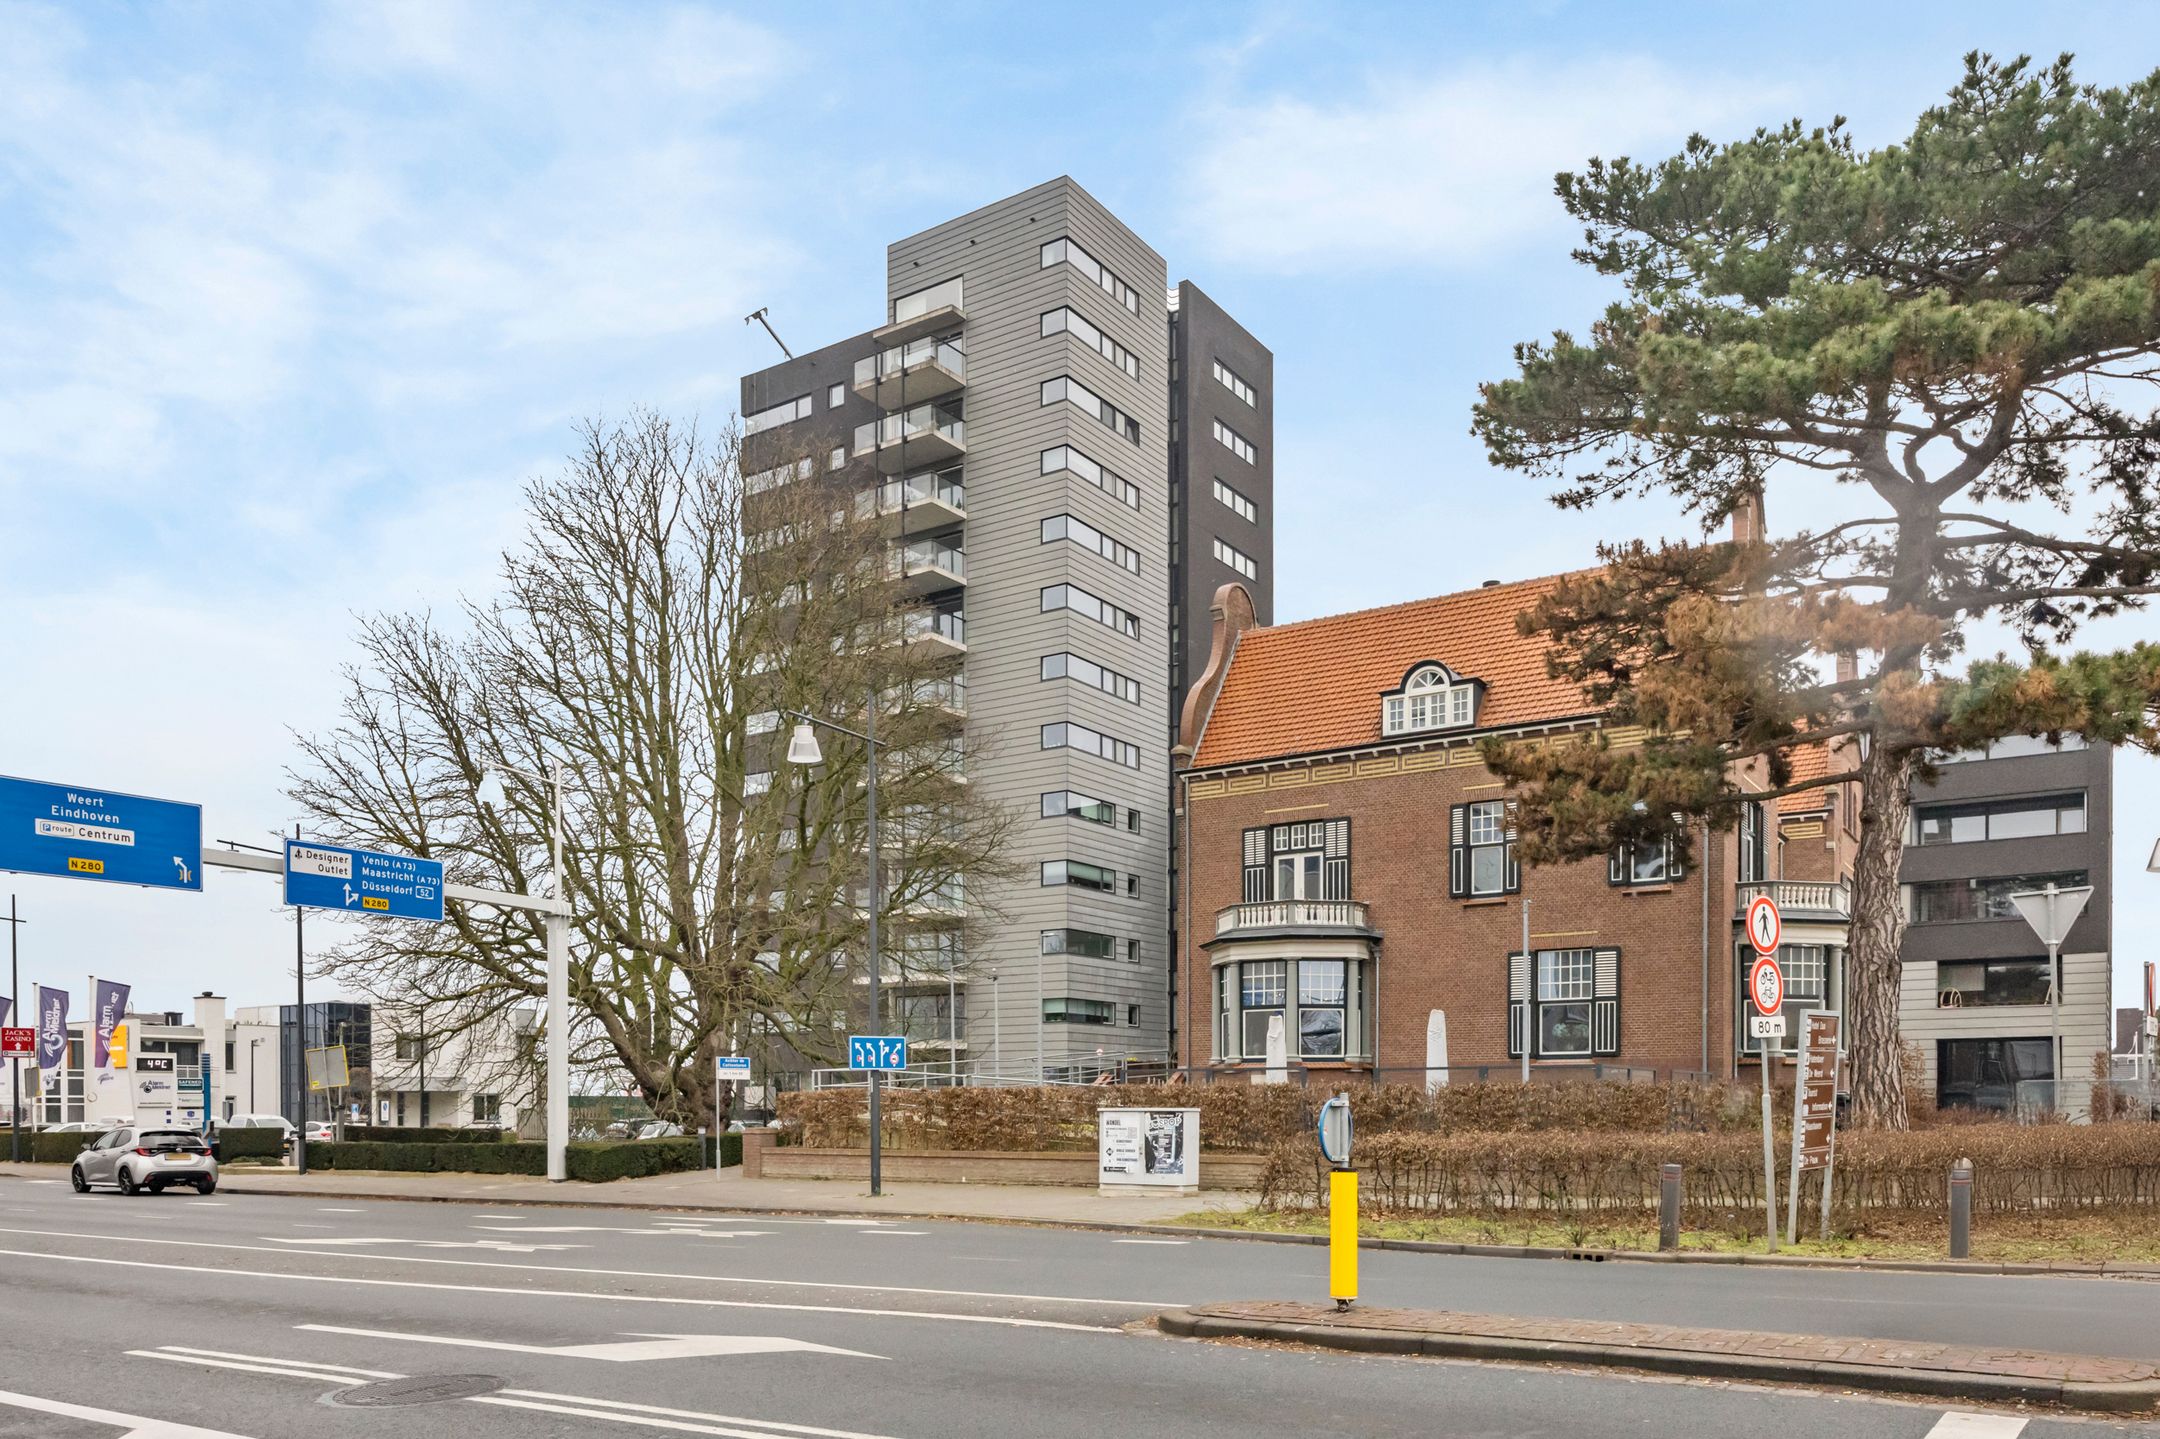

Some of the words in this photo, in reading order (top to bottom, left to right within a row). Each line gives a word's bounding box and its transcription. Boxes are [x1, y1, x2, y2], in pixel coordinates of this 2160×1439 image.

[67, 792, 104, 808] Weert
[52, 805, 120, 824] Eindhoven
[52, 825, 72, 834] route
[79, 828, 130, 842] Centrum
[306, 850, 348, 864] Designer
[362, 855, 389, 868] Venlo
[318, 864, 348, 875] Outlet
[362, 867, 413, 882] Maastricht
[362, 881, 413, 895] Düsseldorf
[42, 1010, 52, 1040] Alarm
[98, 1005, 111, 1038] Alarm
[1758, 1021, 1770, 1033] 80
[1774, 1024, 1781, 1032] m
